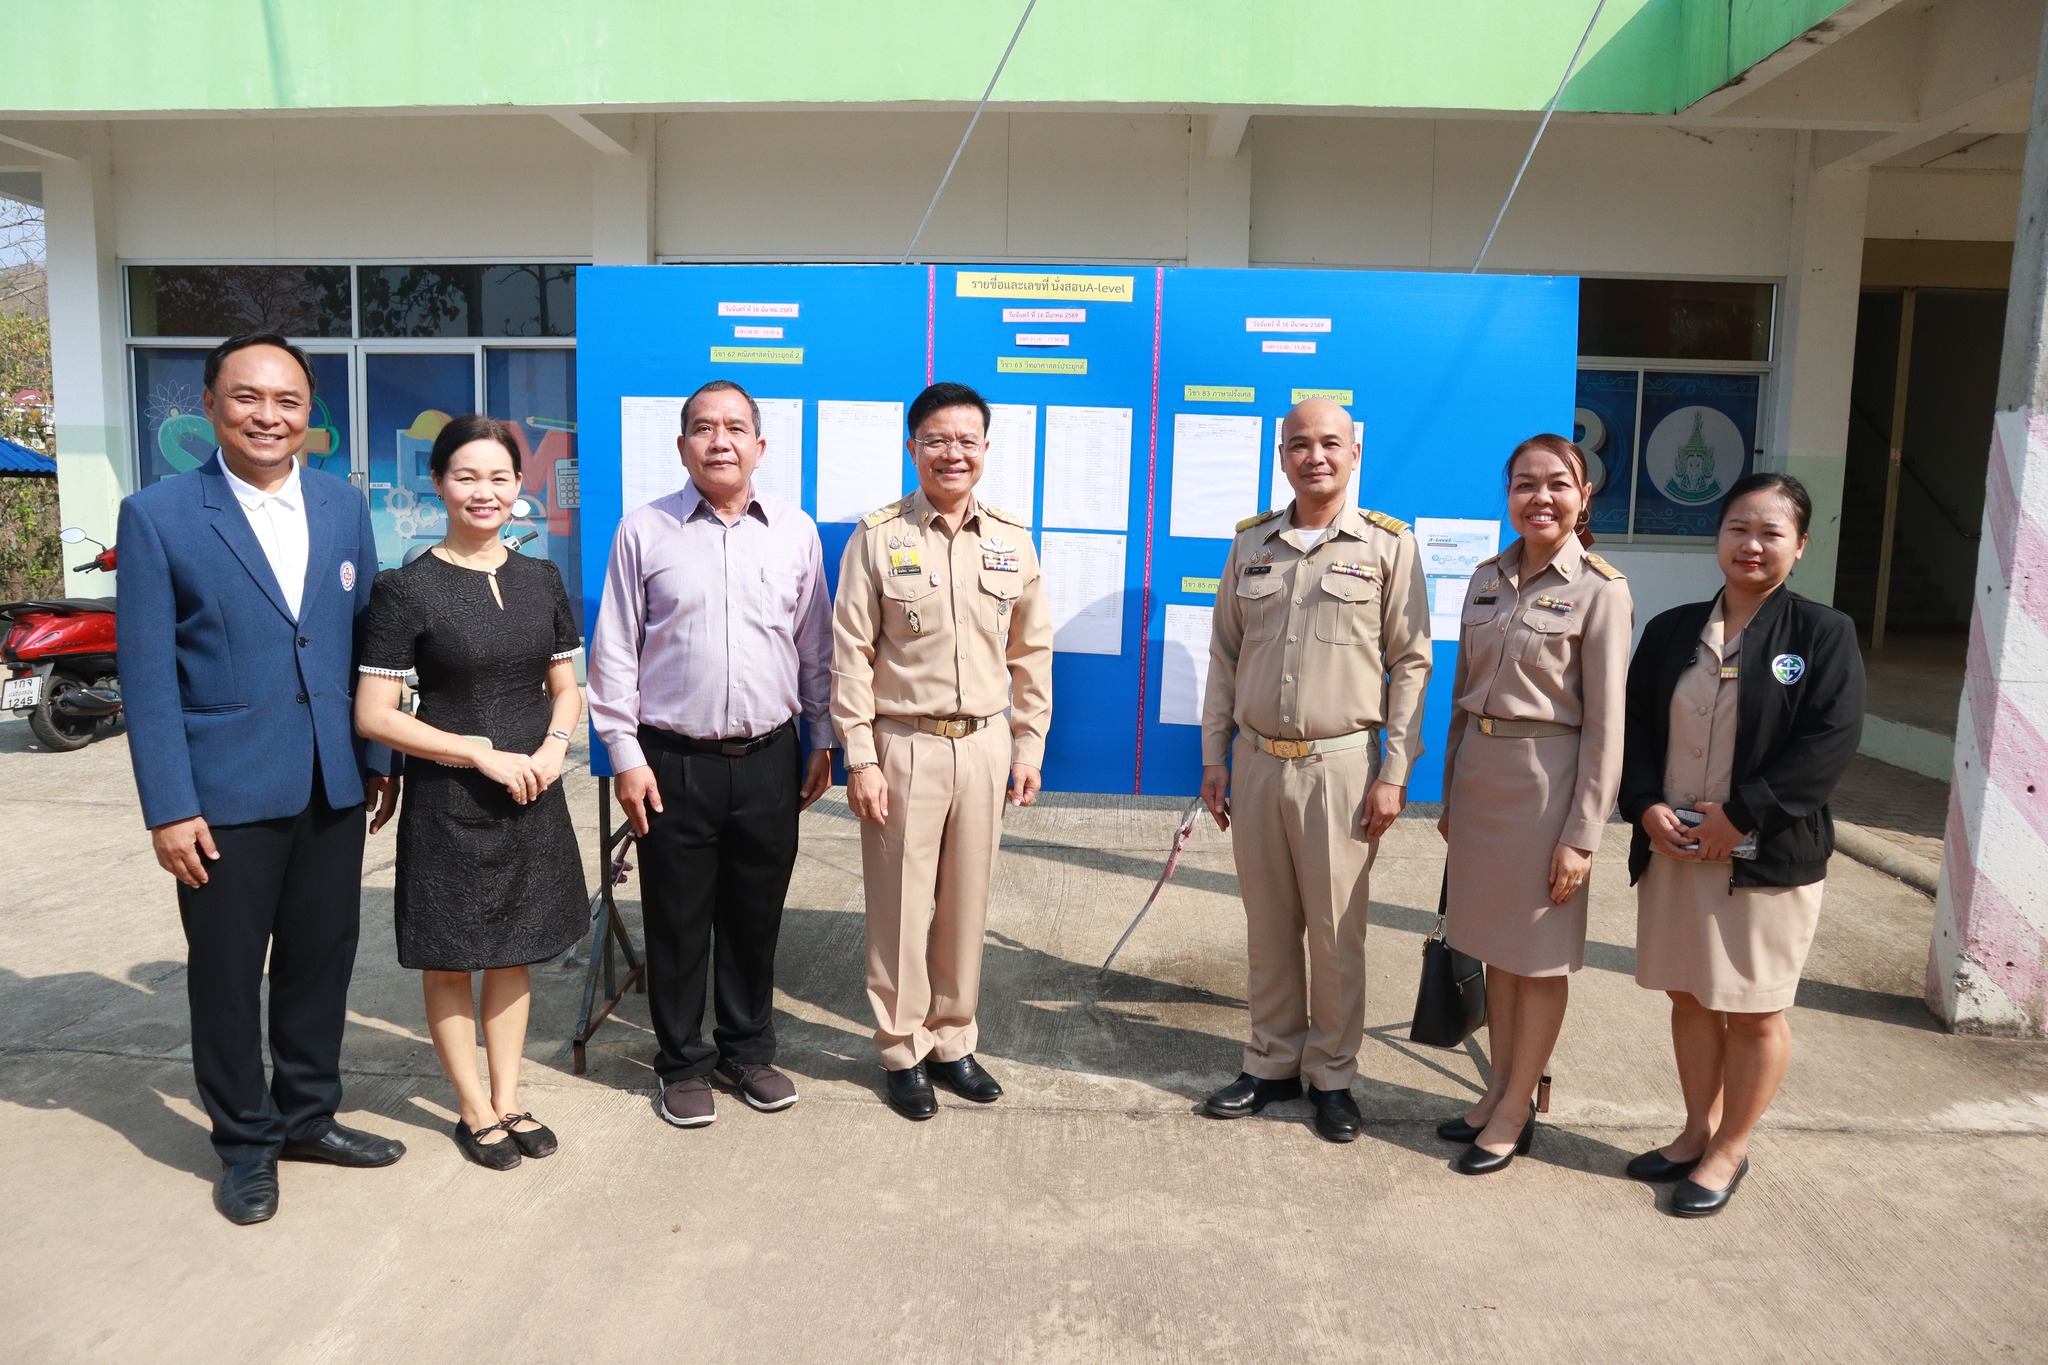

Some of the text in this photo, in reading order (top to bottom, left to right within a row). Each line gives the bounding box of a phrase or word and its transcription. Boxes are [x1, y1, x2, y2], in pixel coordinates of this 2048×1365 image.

[971, 275, 1126, 293] รายชื่อและเลขที่ นั่งสอบA-level
[713, 349, 726, 357] วิชา
[1000, 360, 1013, 368] วิชา
[1187, 388, 1200, 396] วิชา
[1184, 579, 1196, 588] วิชา
[9, 696, 33, 708] 1245
